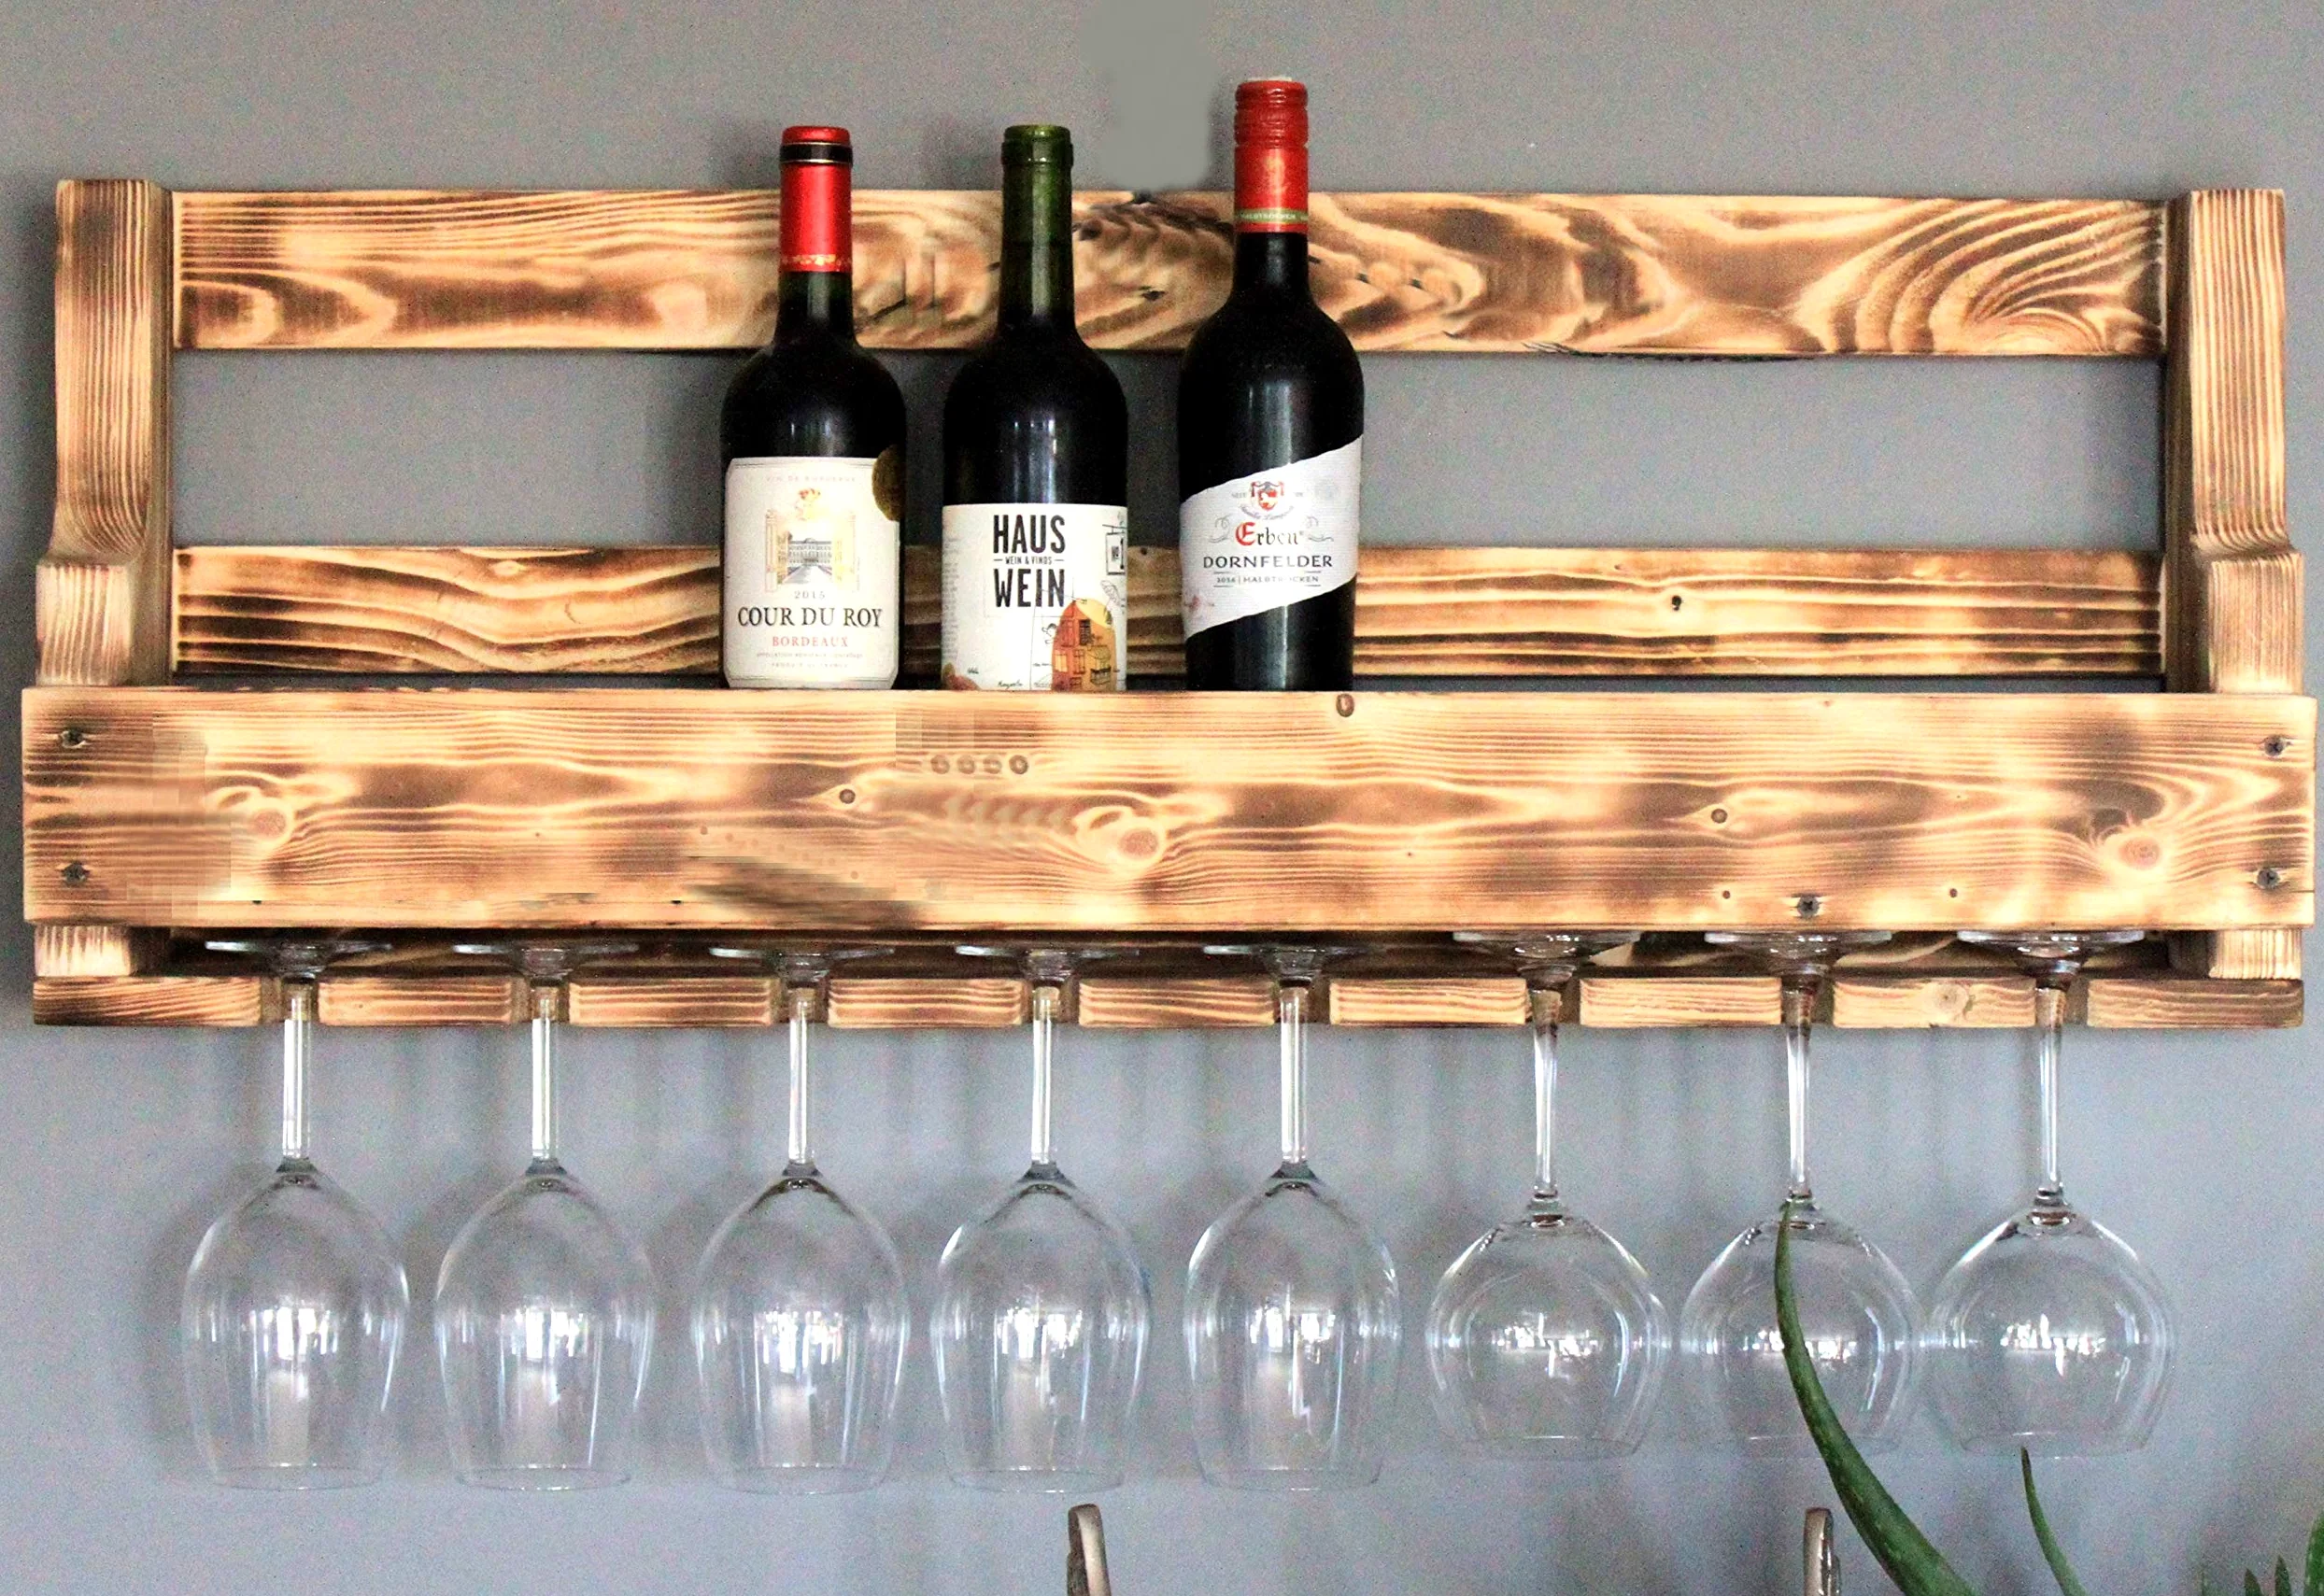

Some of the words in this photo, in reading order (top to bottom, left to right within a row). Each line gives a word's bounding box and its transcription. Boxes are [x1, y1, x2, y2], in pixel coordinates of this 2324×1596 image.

[993, 515, 1066, 554] HAUS
[1235, 521, 1298, 546] Erben
[1005, 556, 1022, 565] WEIN
[1025, 556, 1029, 565] &
[1203, 555, 1333, 569] DORNFELDER
[1243, 575, 1319, 584] HALBTRCKEN
[794, 590, 826, 600] 2015
[993, 568, 1065, 608] WEIN
[738, 607, 795, 628] COUR
[801, 607, 835, 627] DU
[843, 607, 883, 629] ROY
[772, 636, 848, 647] BORDEAUX
